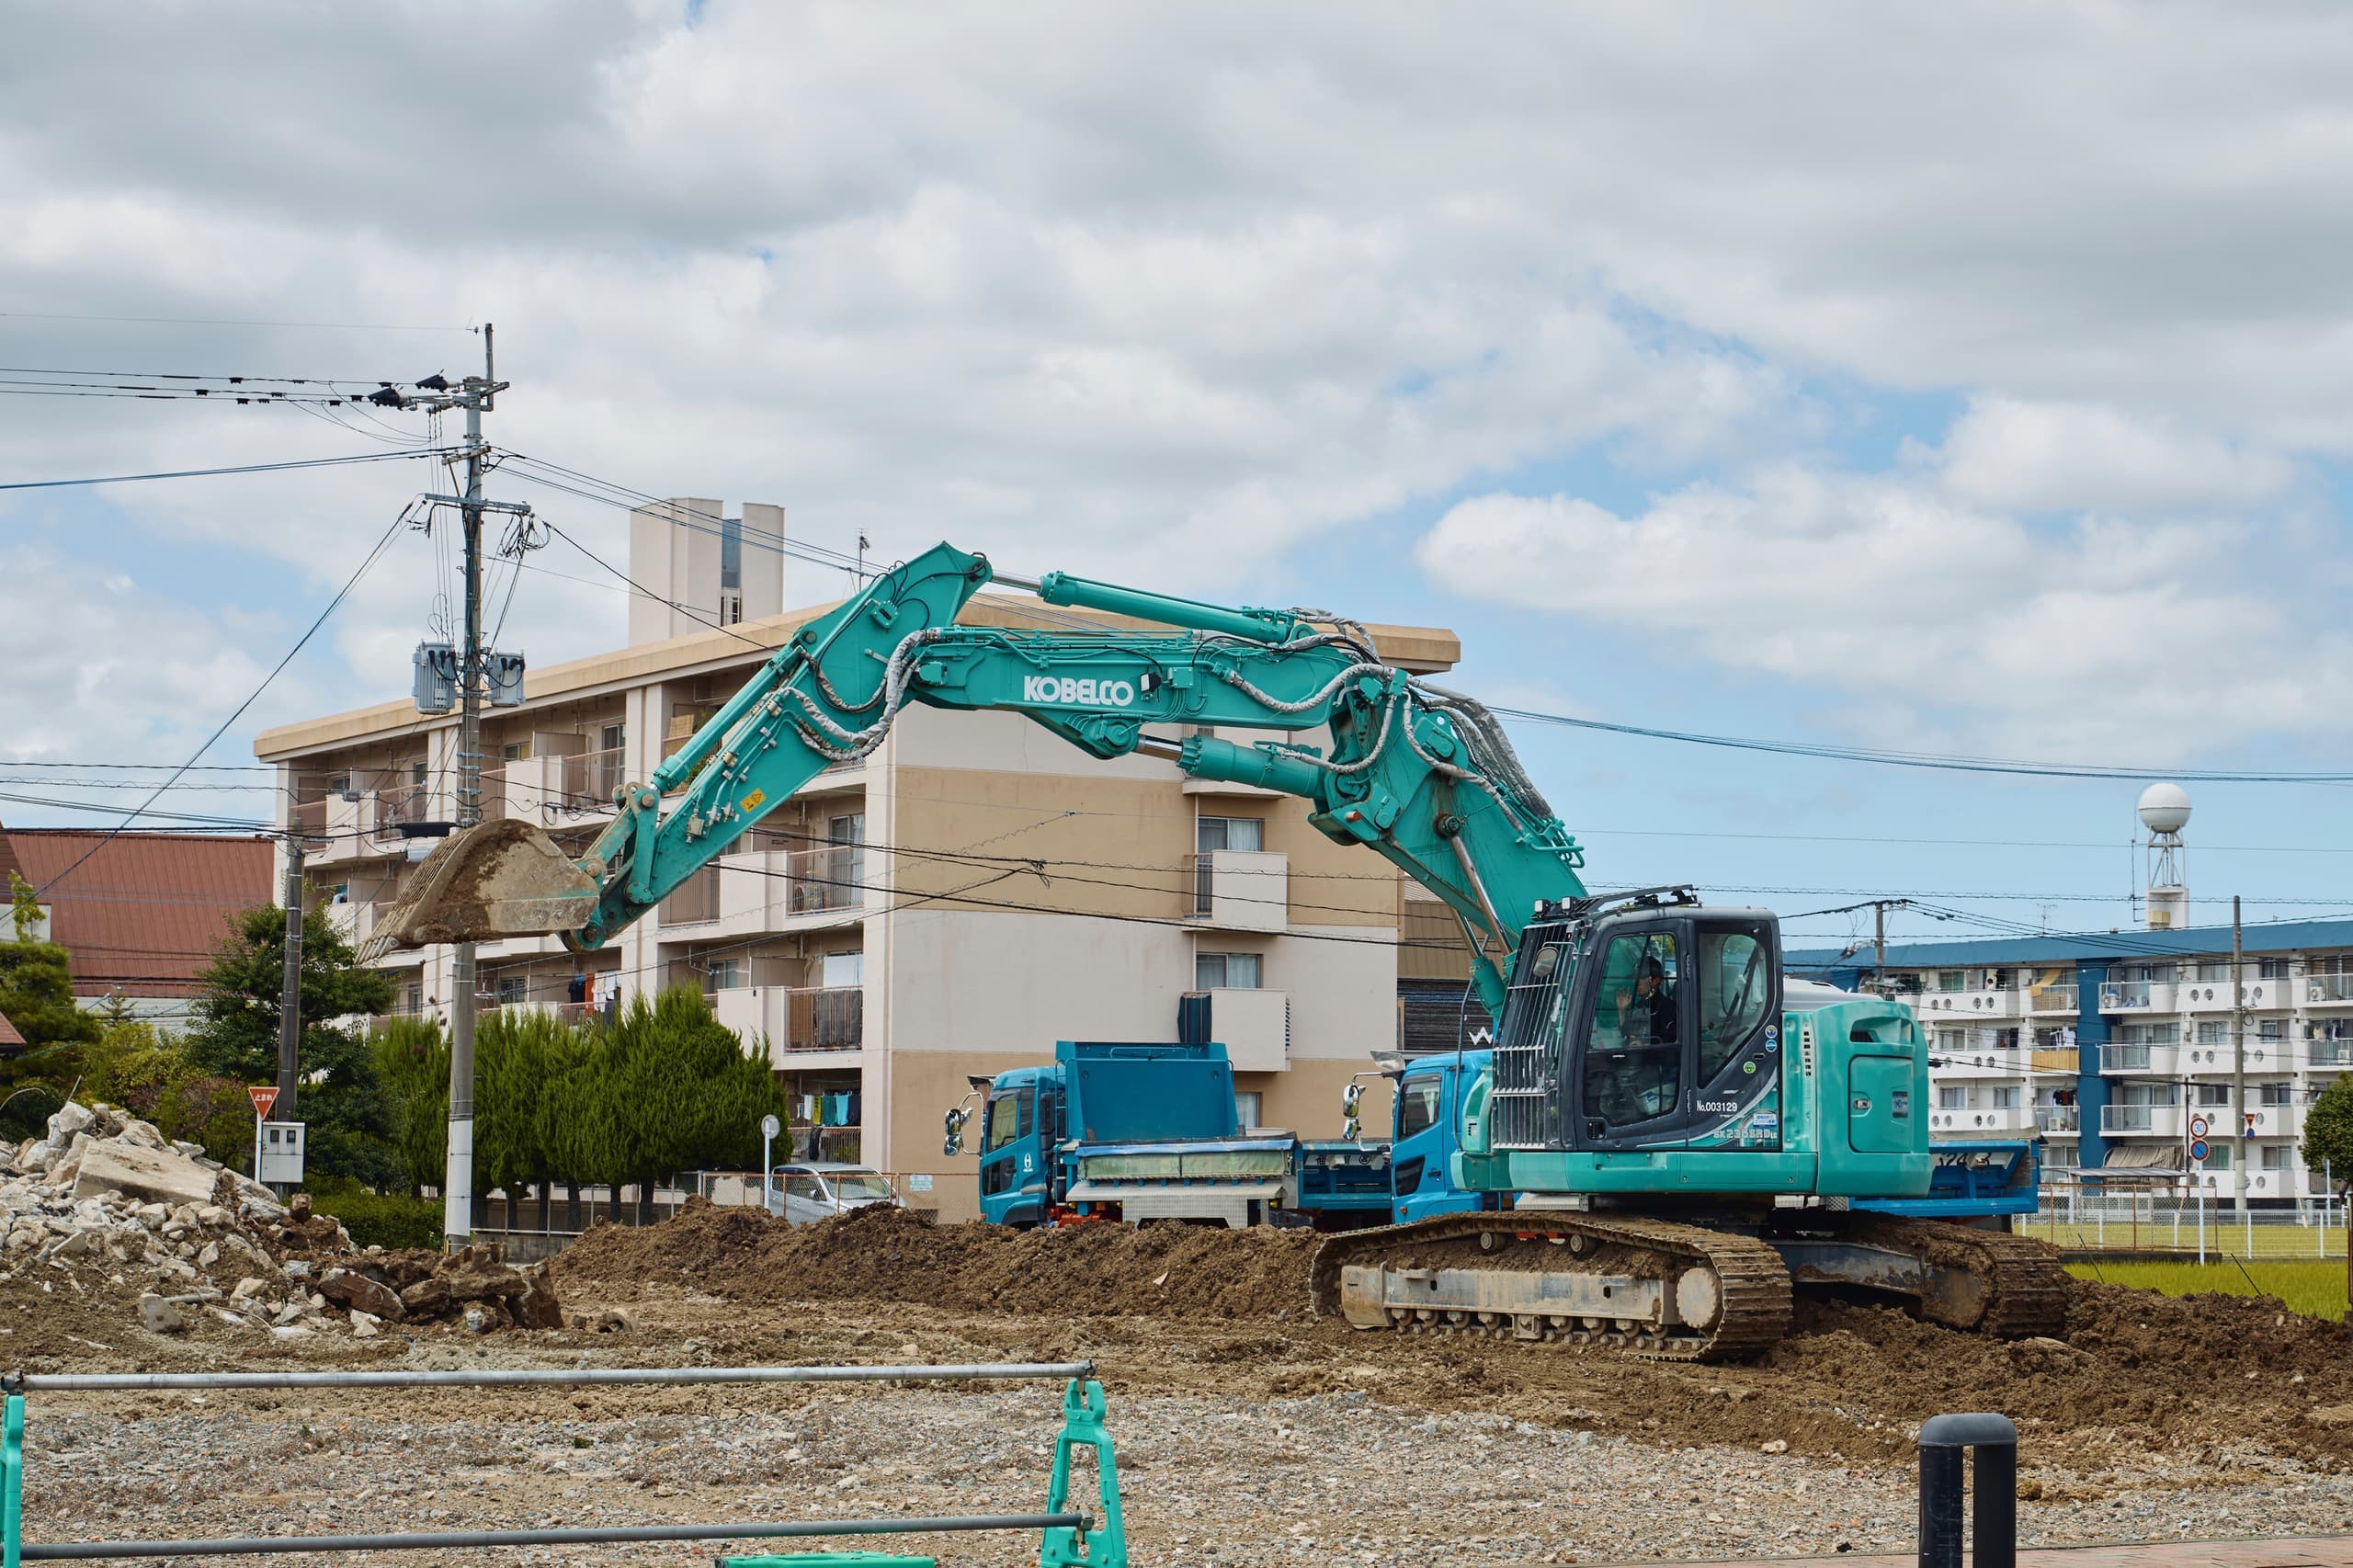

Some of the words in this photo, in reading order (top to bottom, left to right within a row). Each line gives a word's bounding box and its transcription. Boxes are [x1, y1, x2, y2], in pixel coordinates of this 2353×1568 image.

[1024, 676, 1134, 707] KOBELCO
[1696, 1100, 1738, 1112] No.003129
[2194, 1123, 2205, 1133] 30
